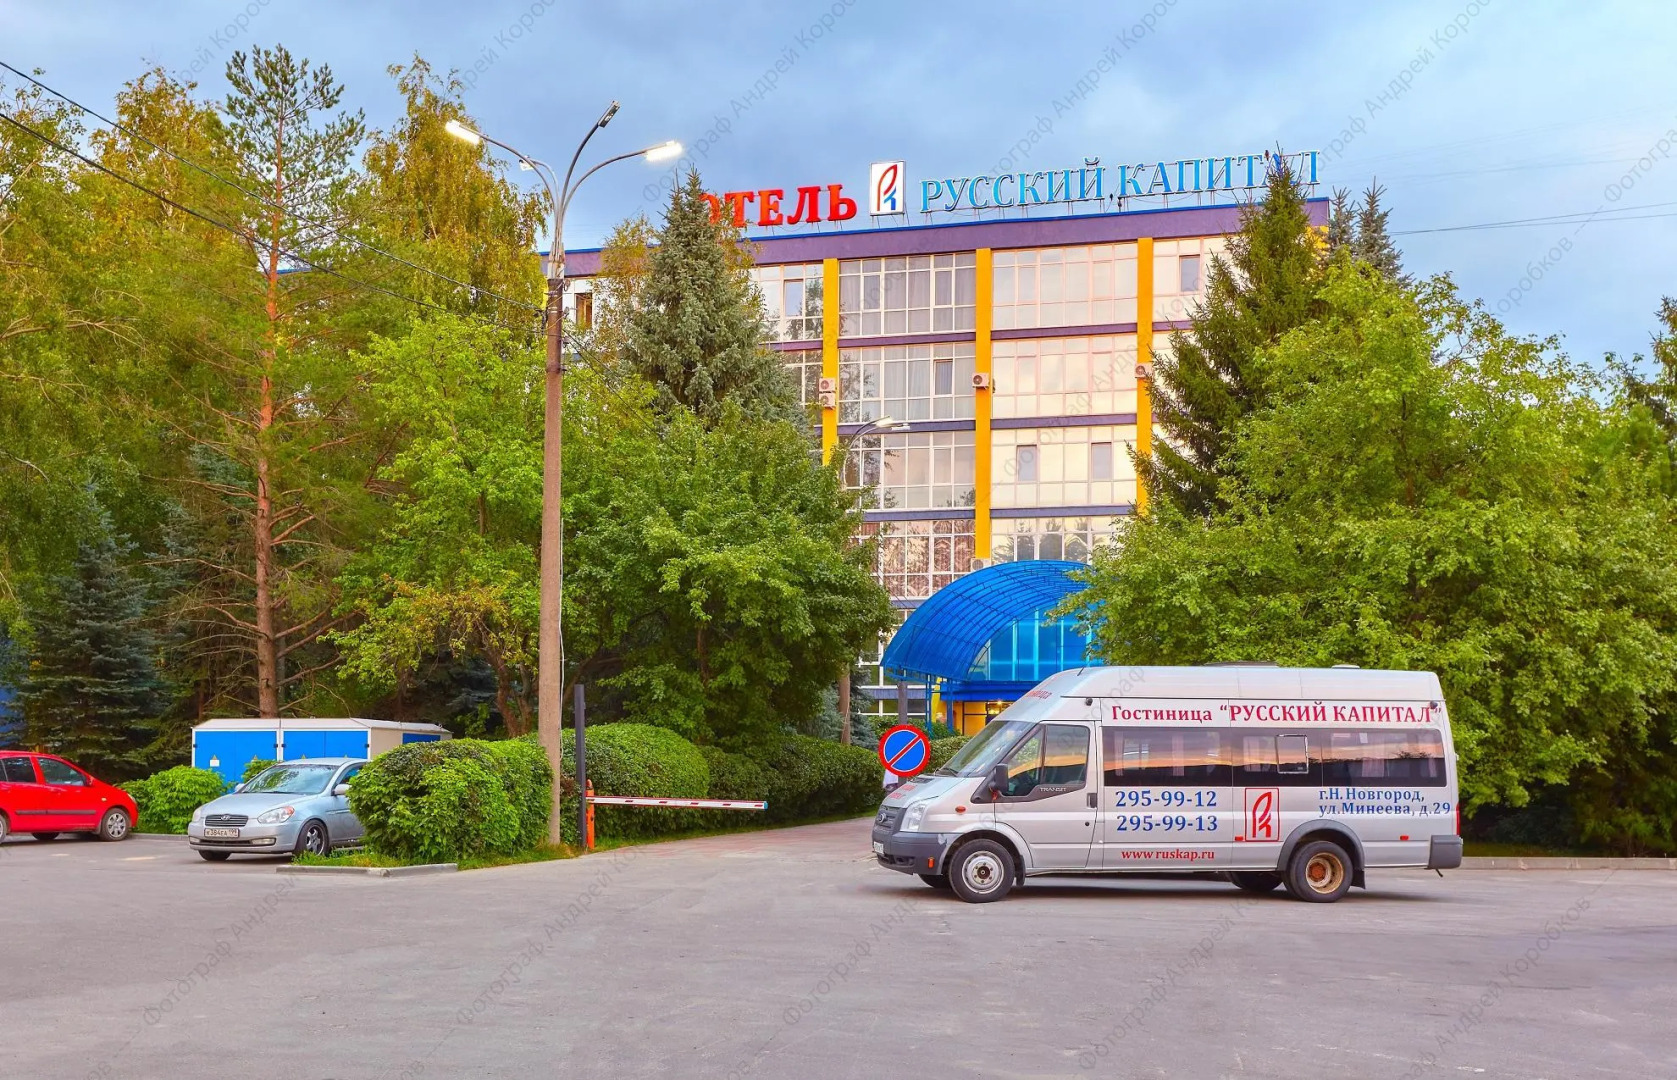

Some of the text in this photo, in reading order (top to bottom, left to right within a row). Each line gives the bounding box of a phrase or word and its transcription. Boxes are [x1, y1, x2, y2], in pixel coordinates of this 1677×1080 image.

[919, 156, 1106, 213] РУССКИЙ
[1112, 706, 1212, 723] Гостиница
[1115, 790, 1217, 807] 295-99-12
[1346, 788, 1425, 803] Новгород,
[1319, 802, 1451, 817] ул.Минеева, д.29
[1116, 815, 1218, 831] 295-99-13
